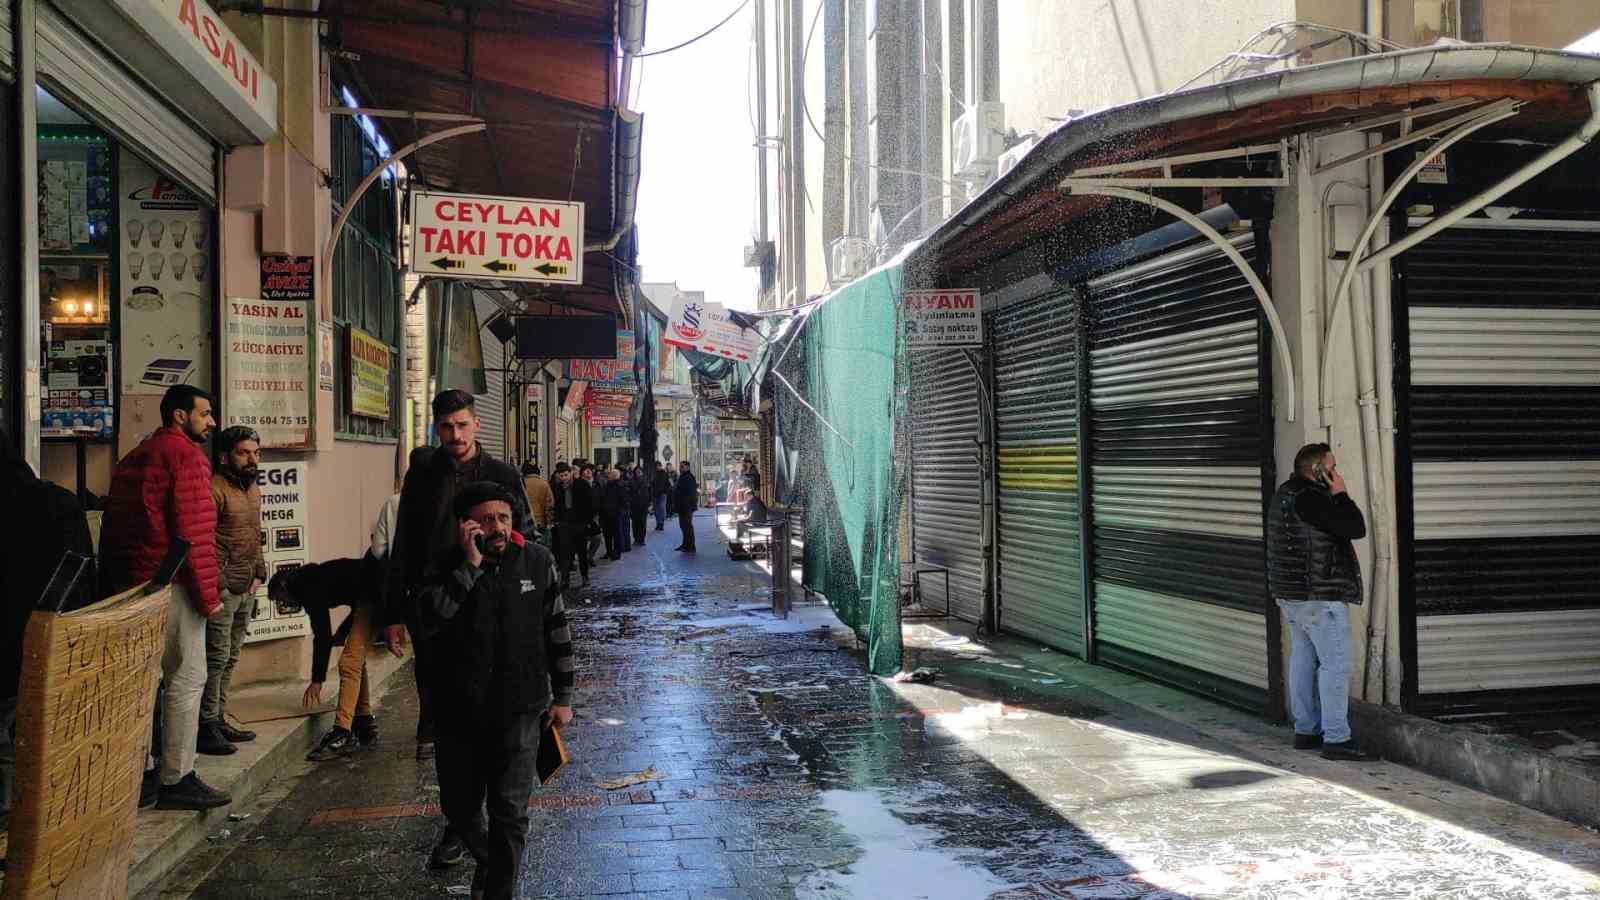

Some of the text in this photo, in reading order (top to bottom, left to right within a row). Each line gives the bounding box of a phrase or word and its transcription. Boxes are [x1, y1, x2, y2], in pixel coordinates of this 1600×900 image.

[177, 0, 257, 99] ASAJI
[435, 201, 560, 228] CEYLAN
[420, 227, 573, 261] TAKI TOKA
[231, 303, 304, 318] YASİN AL
[255, 468, 298, 485] EGA
[261, 492, 299, 504] TRONİK
